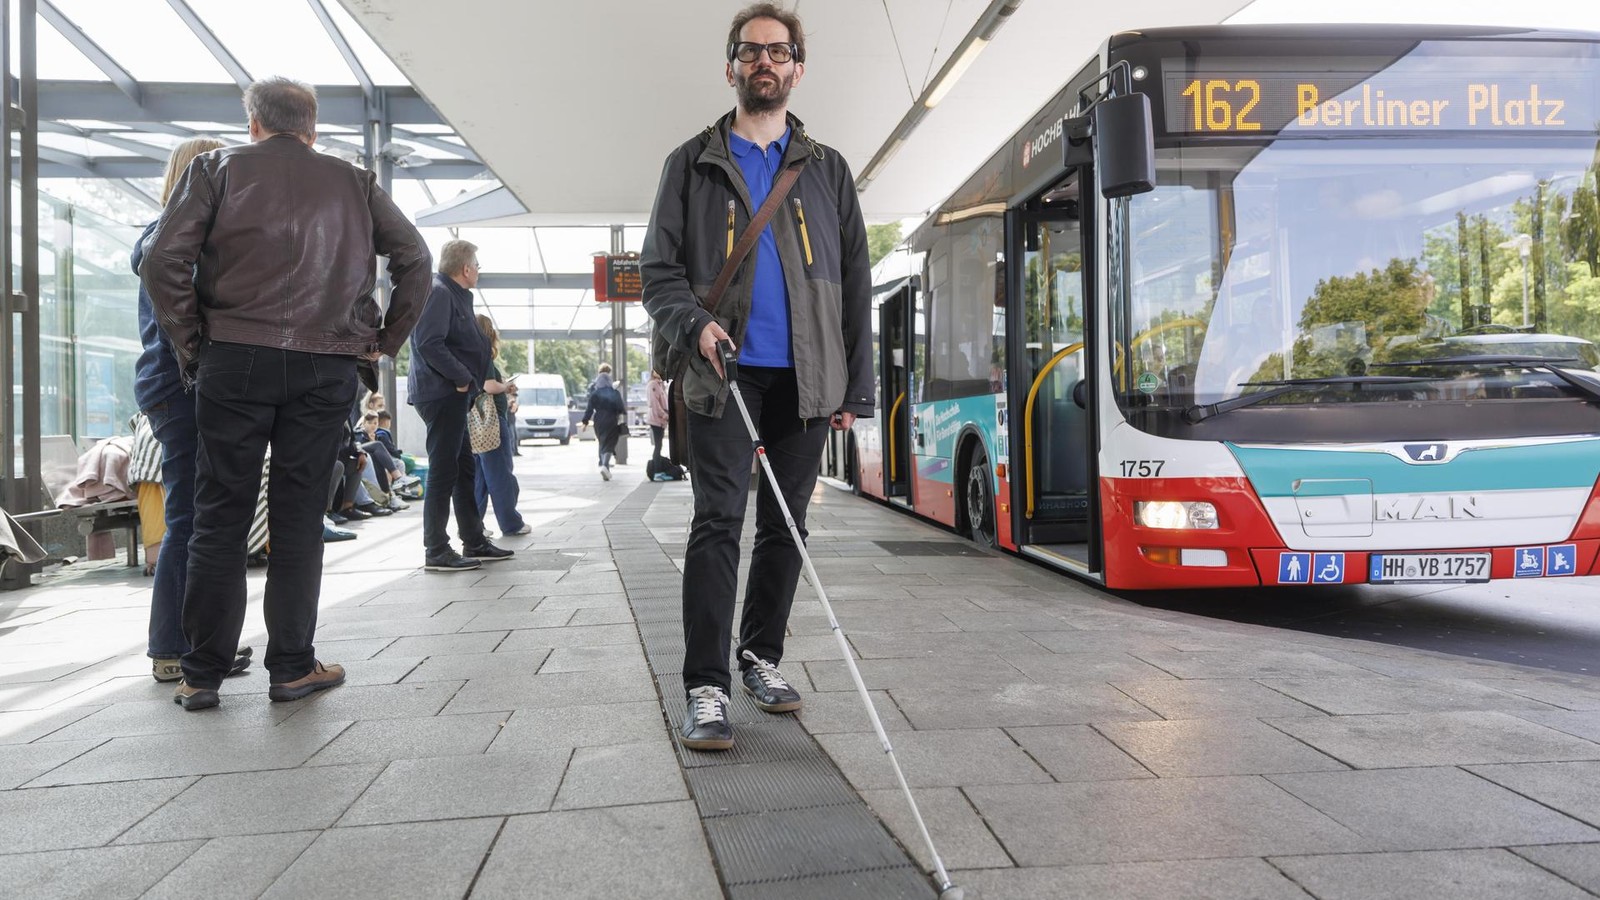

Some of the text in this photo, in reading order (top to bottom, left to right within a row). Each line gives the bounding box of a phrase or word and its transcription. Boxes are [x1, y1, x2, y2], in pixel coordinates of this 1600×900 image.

[1182, 80, 1566, 131] 162 Berliner Platz
[1120, 460, 1165, 478] 1757
[1374, 495, 1484, 520] MAN
[1383, 557, 1405, 577] HH
[1419, 557, 1440, 576] YB
[1443, 557, 1487, 576] 1757
